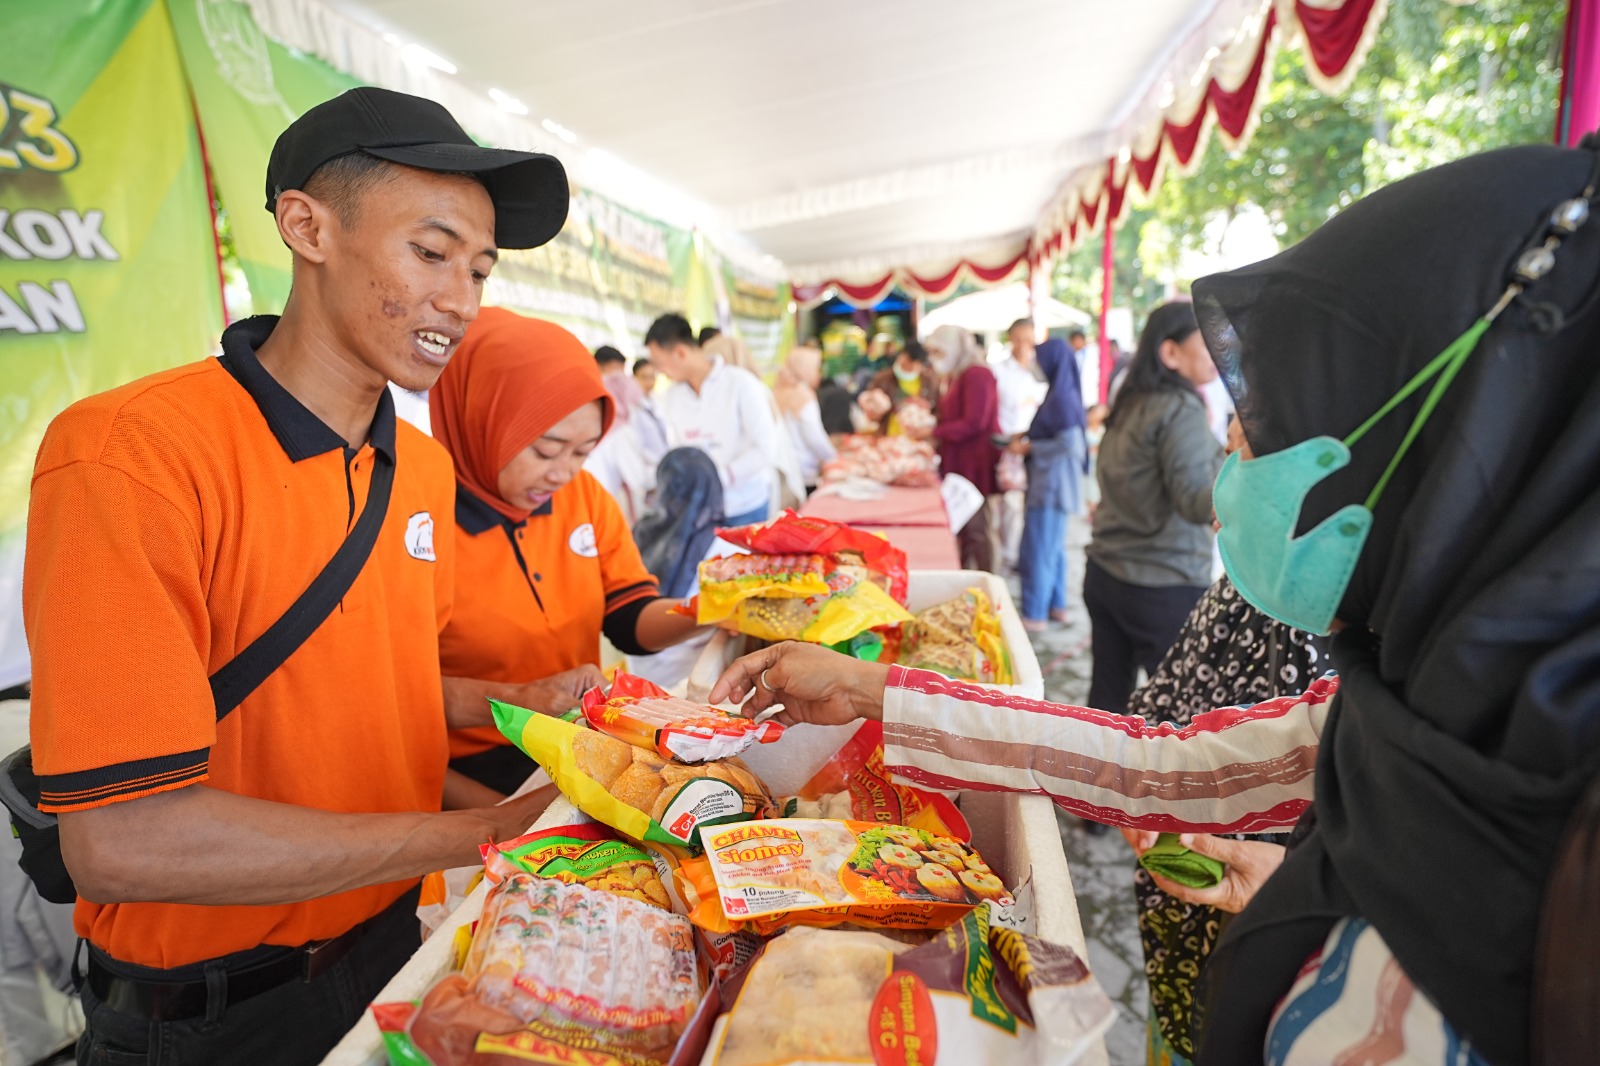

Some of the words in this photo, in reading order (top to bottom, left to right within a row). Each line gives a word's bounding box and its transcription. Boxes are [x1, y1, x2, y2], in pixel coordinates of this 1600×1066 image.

[854, 769, 886, 808] hicken
[713, 826, 797, 847] CHAMP
[717, 843, 804, 865] Siomay
[742, 887, 757, 897] 10
[732, 906, 748, 914] CP
